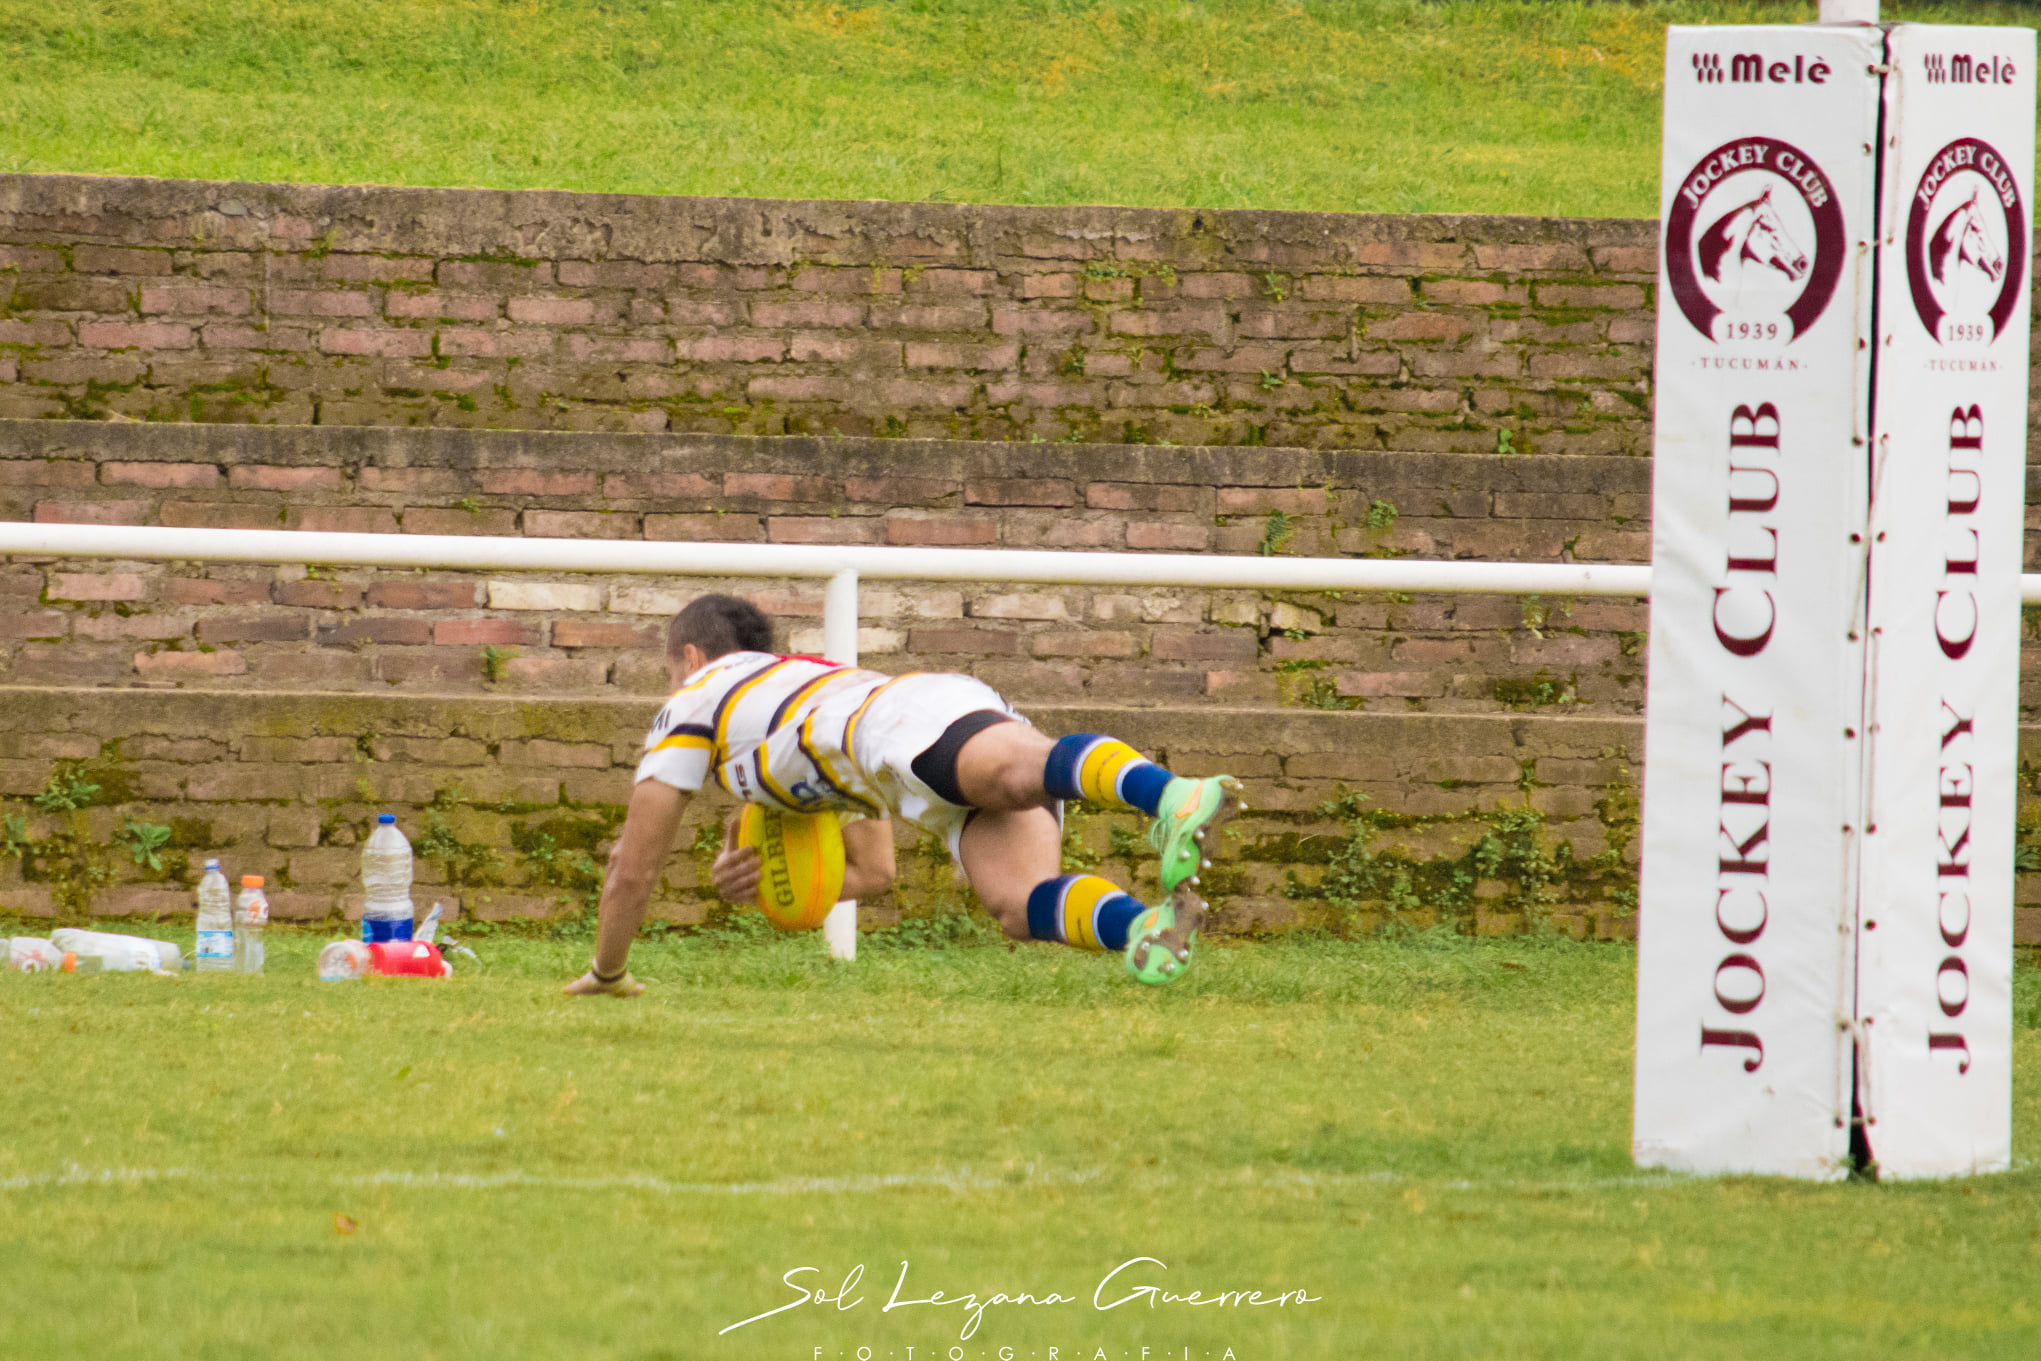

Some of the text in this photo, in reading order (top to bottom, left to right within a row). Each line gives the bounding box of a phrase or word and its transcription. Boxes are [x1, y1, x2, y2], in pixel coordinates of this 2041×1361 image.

[1730, 53, 1832, 85] Melè
[1950, 53, 2017, 85] Melè
[1681, 144, 1829, 210] JOCKEY CLUB
[1917, 144, 2016, 210] JOCKEY CLUB
[1727, 322, 1778, 341] 1939
[1948, 323, 1984, 341] 1939
[1699, 401, 1781, 1075] JOCKEY CLUB
[1927, 403, 1984, 1077] JOCKEY CLUB
